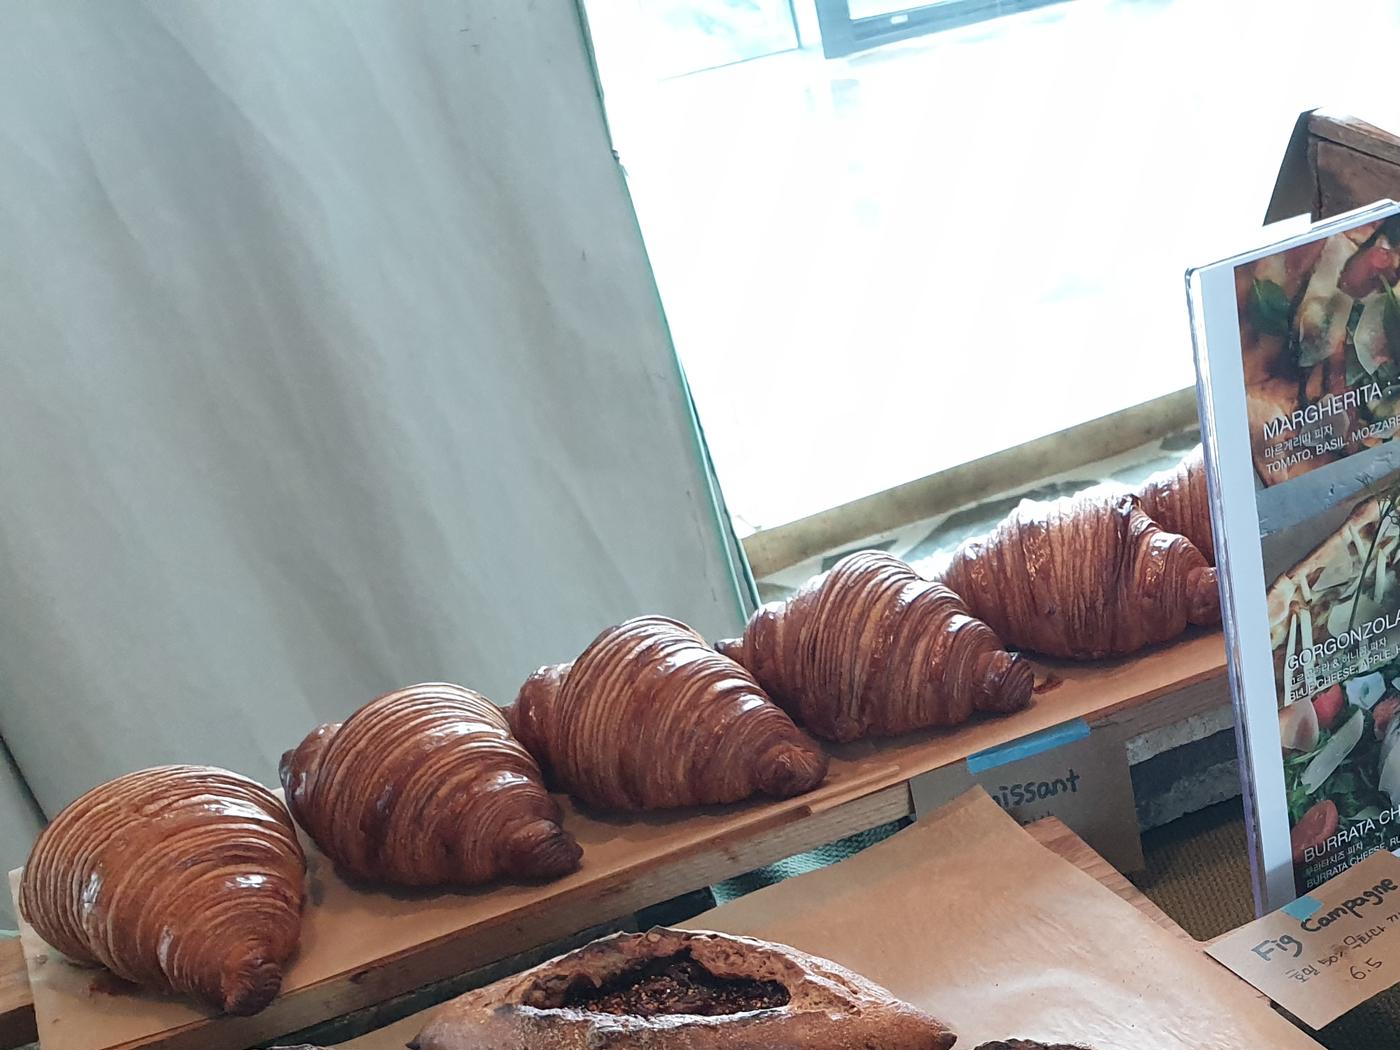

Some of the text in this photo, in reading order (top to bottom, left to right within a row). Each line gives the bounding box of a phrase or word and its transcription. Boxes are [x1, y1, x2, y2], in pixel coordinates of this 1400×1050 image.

[1263, 382, 1382, 441] MARGHERITA
[1315, 424, 1333, 439] 피자
[1370, 636, 1387, 650] 피자
[1290, 682, 1317, 701] BLUE
[1304, 818, 1376, 863] BURRATA
[1347, 841, 1363, 855] 피자
[1307, 862, 1348, 889] BURRATA
[1250, 877, 1399, 961] Fig Campagne
[1350, 958, 1383, 981] 6.5
